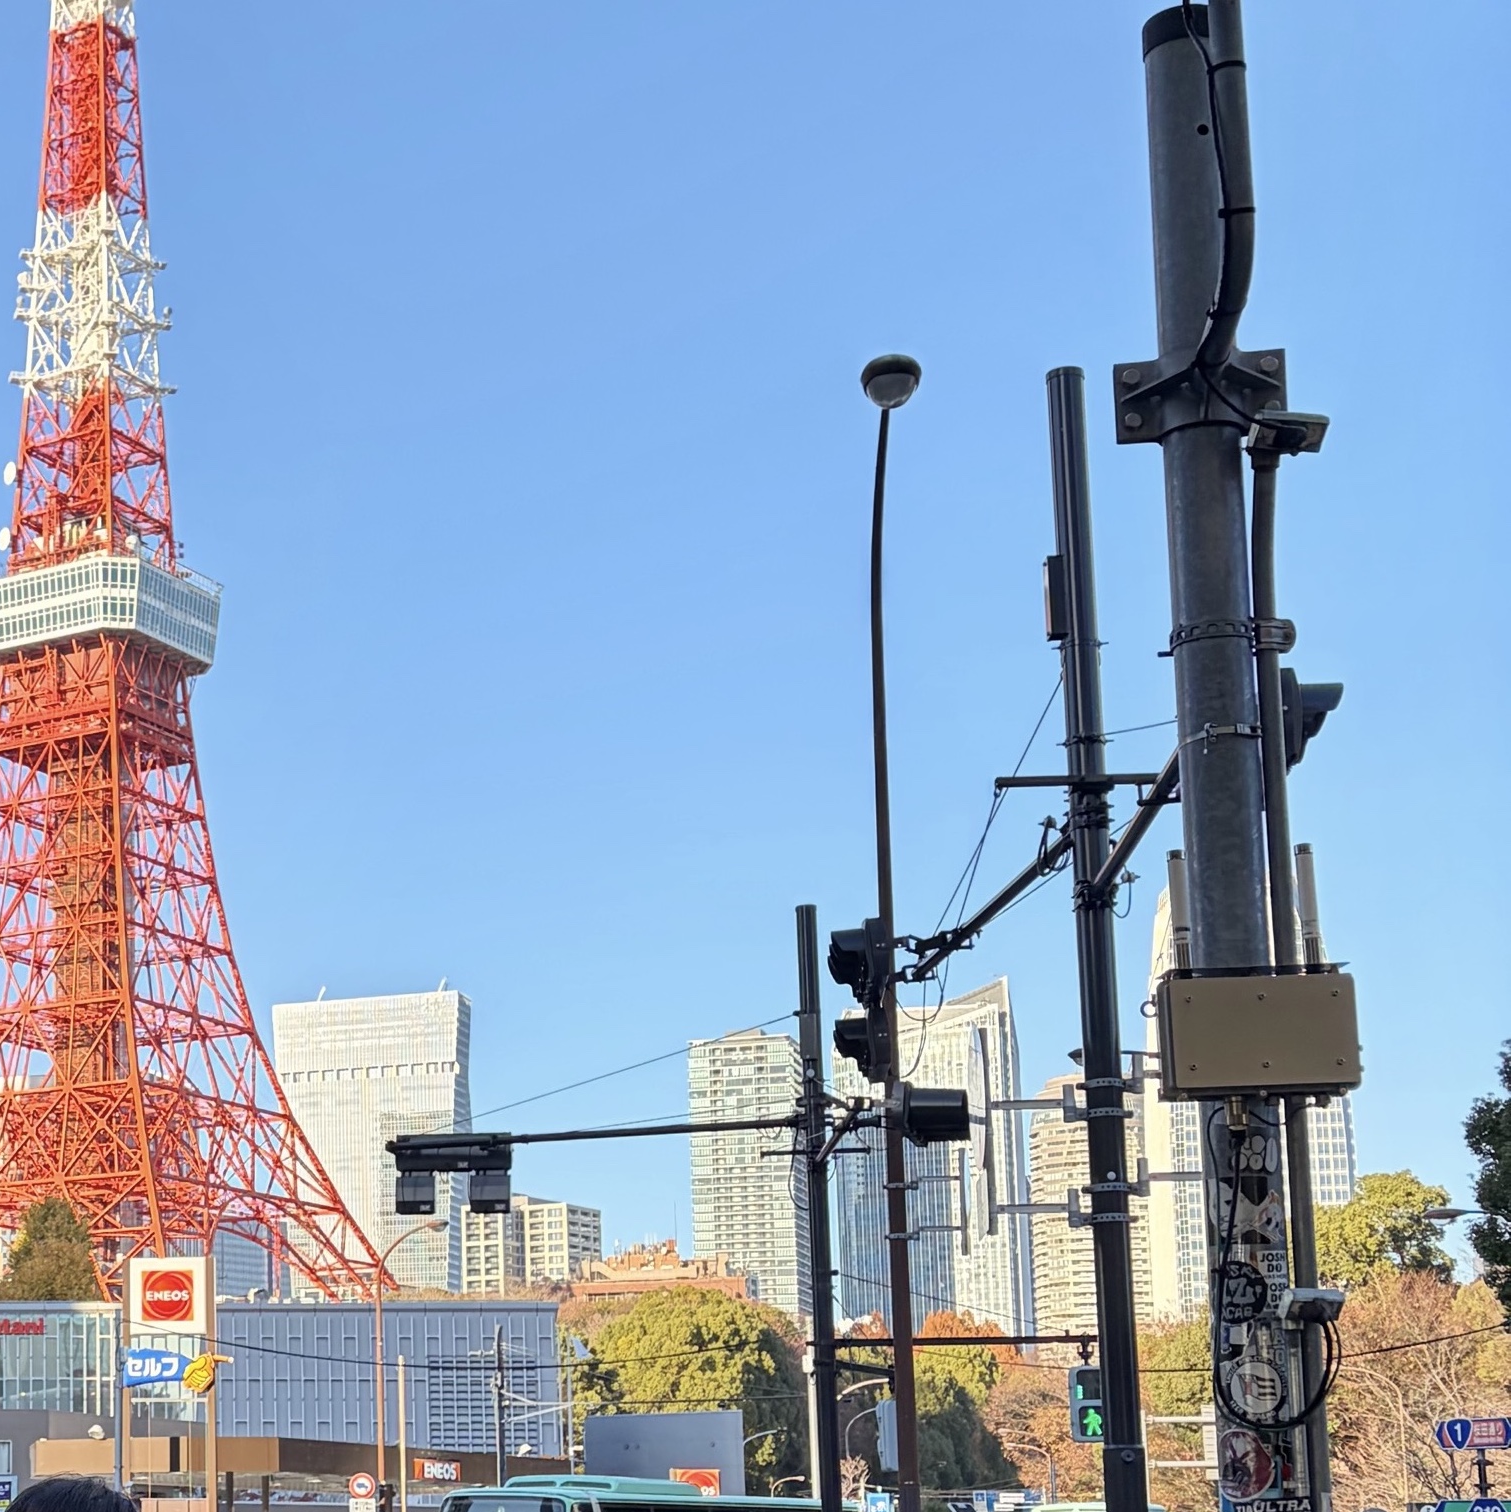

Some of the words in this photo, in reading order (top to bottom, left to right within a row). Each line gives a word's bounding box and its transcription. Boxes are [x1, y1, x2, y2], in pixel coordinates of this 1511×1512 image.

[145, 1289, 190, 1302] ENEOS
[126, 1357, 179, 1377] セルフ
[1453, 1422, 1463, 1442] 1
[423, 1461, 457, 1481] ENEOS
